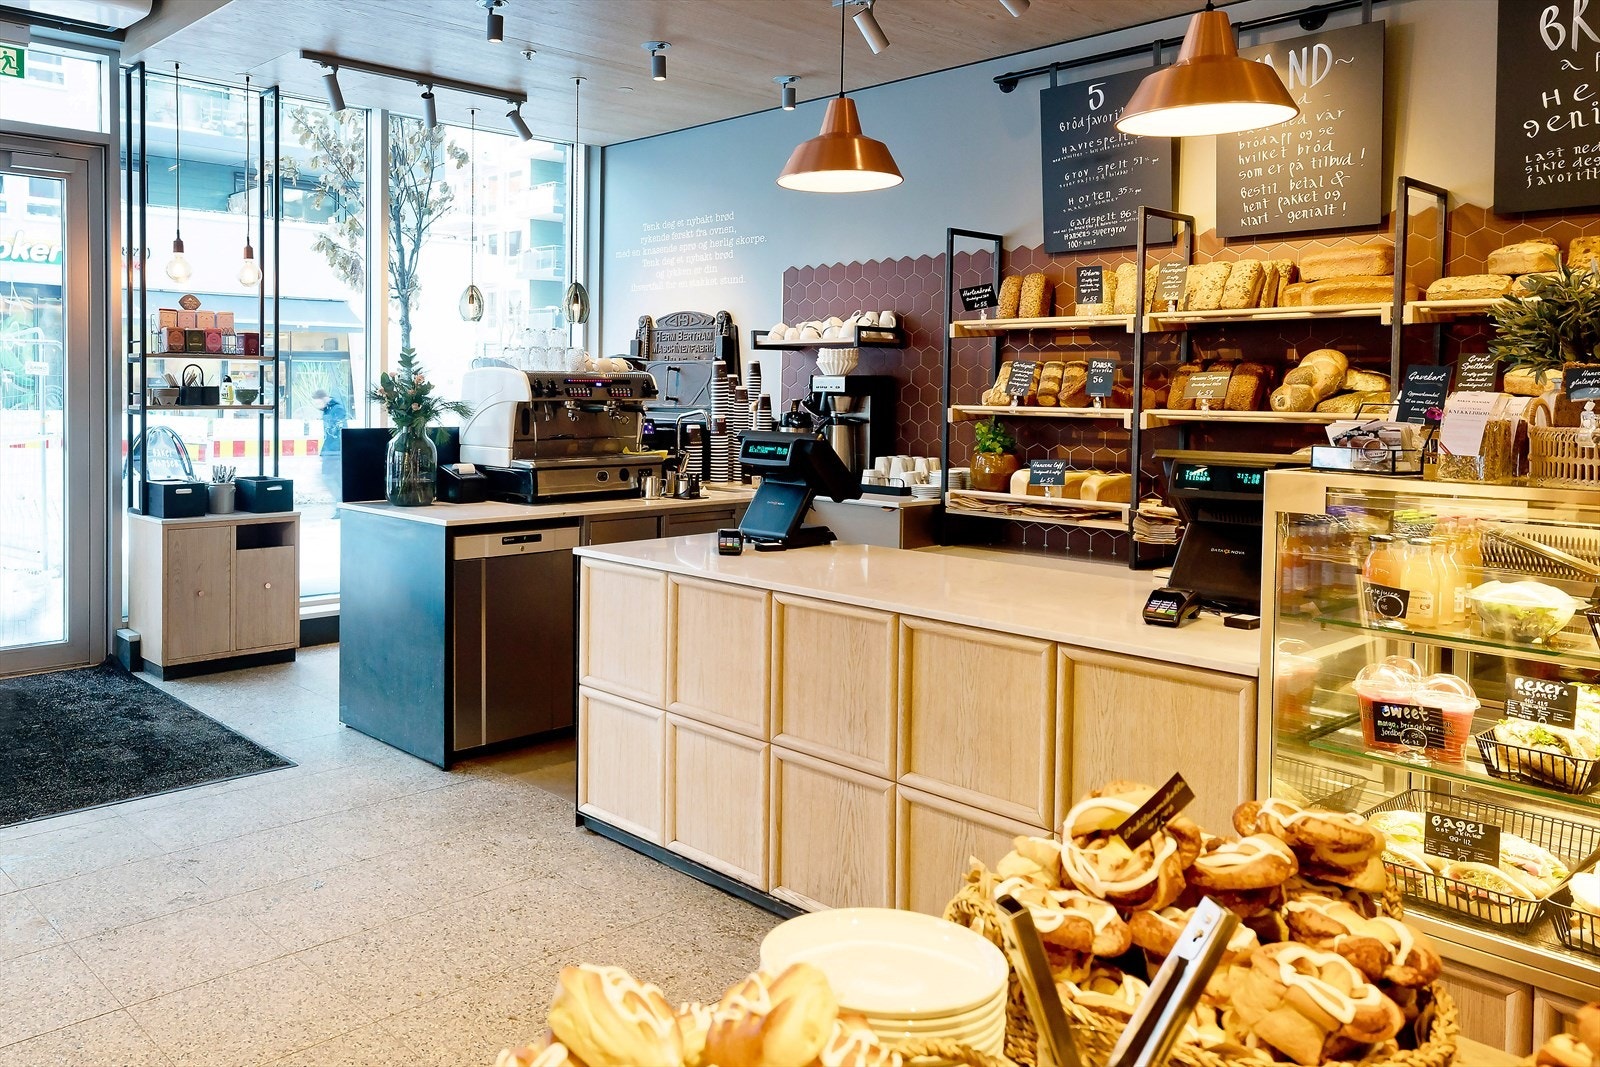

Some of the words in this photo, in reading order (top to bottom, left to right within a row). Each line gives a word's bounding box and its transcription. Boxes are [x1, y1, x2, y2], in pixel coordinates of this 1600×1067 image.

[1088, 82, 1106, 111] 5
[1300, 130, 1313, 140] og
[1319, 126, 1334, 135] se
[1238, 146, 1288, 165] hvilket
[1064, 168, 1089, 181] Grov
[1097, 158, 1128, 176] spelt
[1238, 166, 1262, 180] som
[1268, 164, 1285, 174] er
[1290, 159, 1304, 178] på
[1311, 153, 1355, 170] tilbud
[1525, 158, 1565, 174] sikre
[1290, 175, 1324, 191] betal
[1331, 171, 1350, 187] &
[1068, 190, 1111, 205] Horten
[1243, 198, 1270, 213] hent
[1278, 190, 1323, 213] pakket
[1325, 190, 1341, 201] og
[643, 223, 660, 232] Tenk
[662, 221, 675, 230] deg
[686, 214, 713, 227] nybakt
[715, 211, 735, 221] brød
[1288, 203, 1337, 223] genialt
[640, 233, 670, 245] rykende
[698, 241, 708, 250] og
[710, 236, 733, 248] herlig
[714, 250, 734, 259] brød
[1092, 376, 1104, 384] 56
[1408, 371, 1447, 381] Gavekort
[1515, 677, 1564, 695] Reker
[1432, 815, 1485, 834] Bagel
